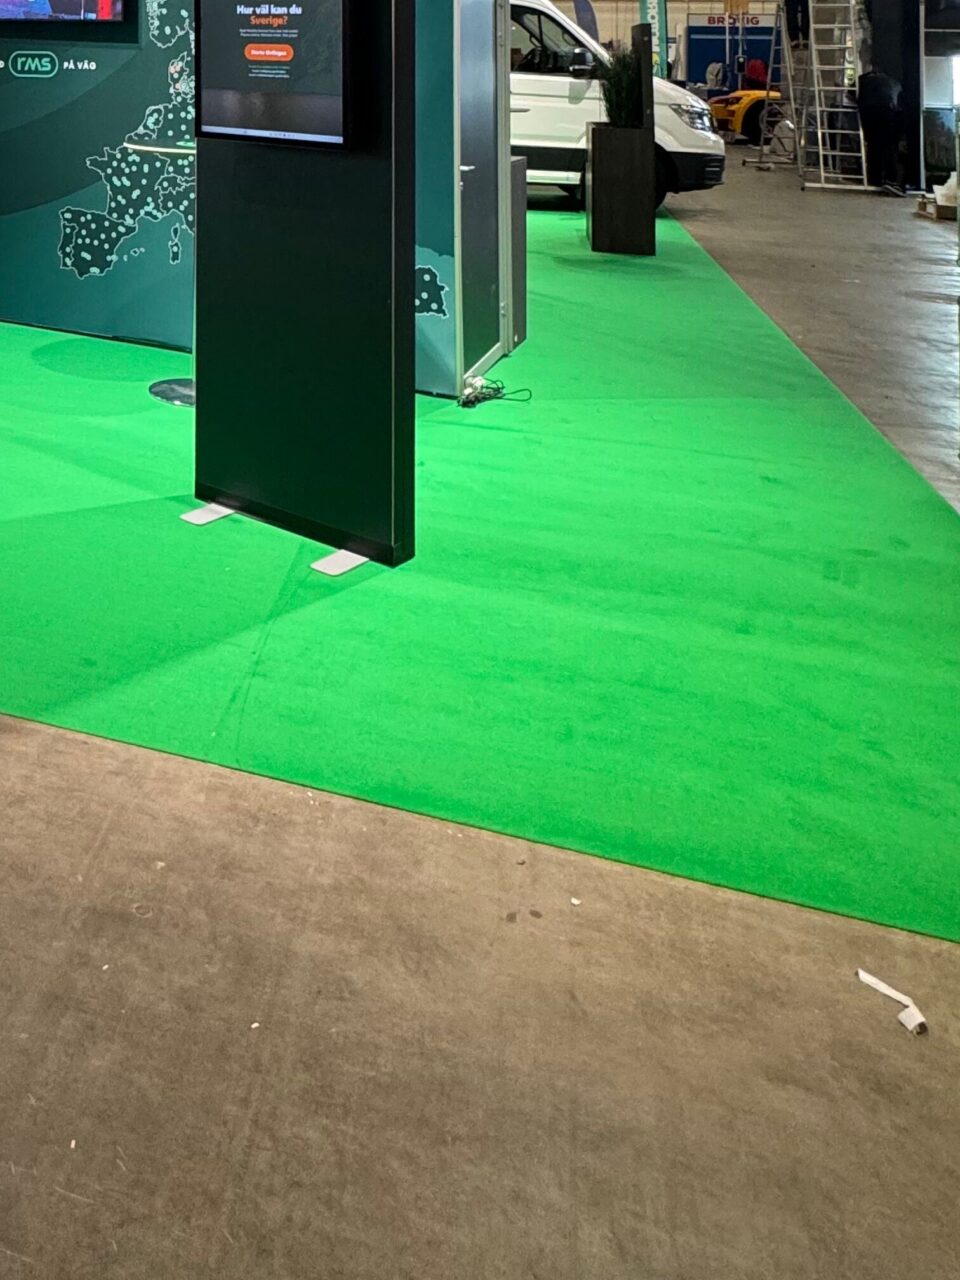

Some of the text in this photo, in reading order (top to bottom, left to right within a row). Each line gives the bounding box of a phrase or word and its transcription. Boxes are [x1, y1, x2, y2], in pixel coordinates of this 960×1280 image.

[236, 4, 302, 15] Hur väl kan du
[250, 15, 288, 28] Sverige?
[63, 61, 75, 70] PÅ
[77, 61, 97, 70] VÄG
